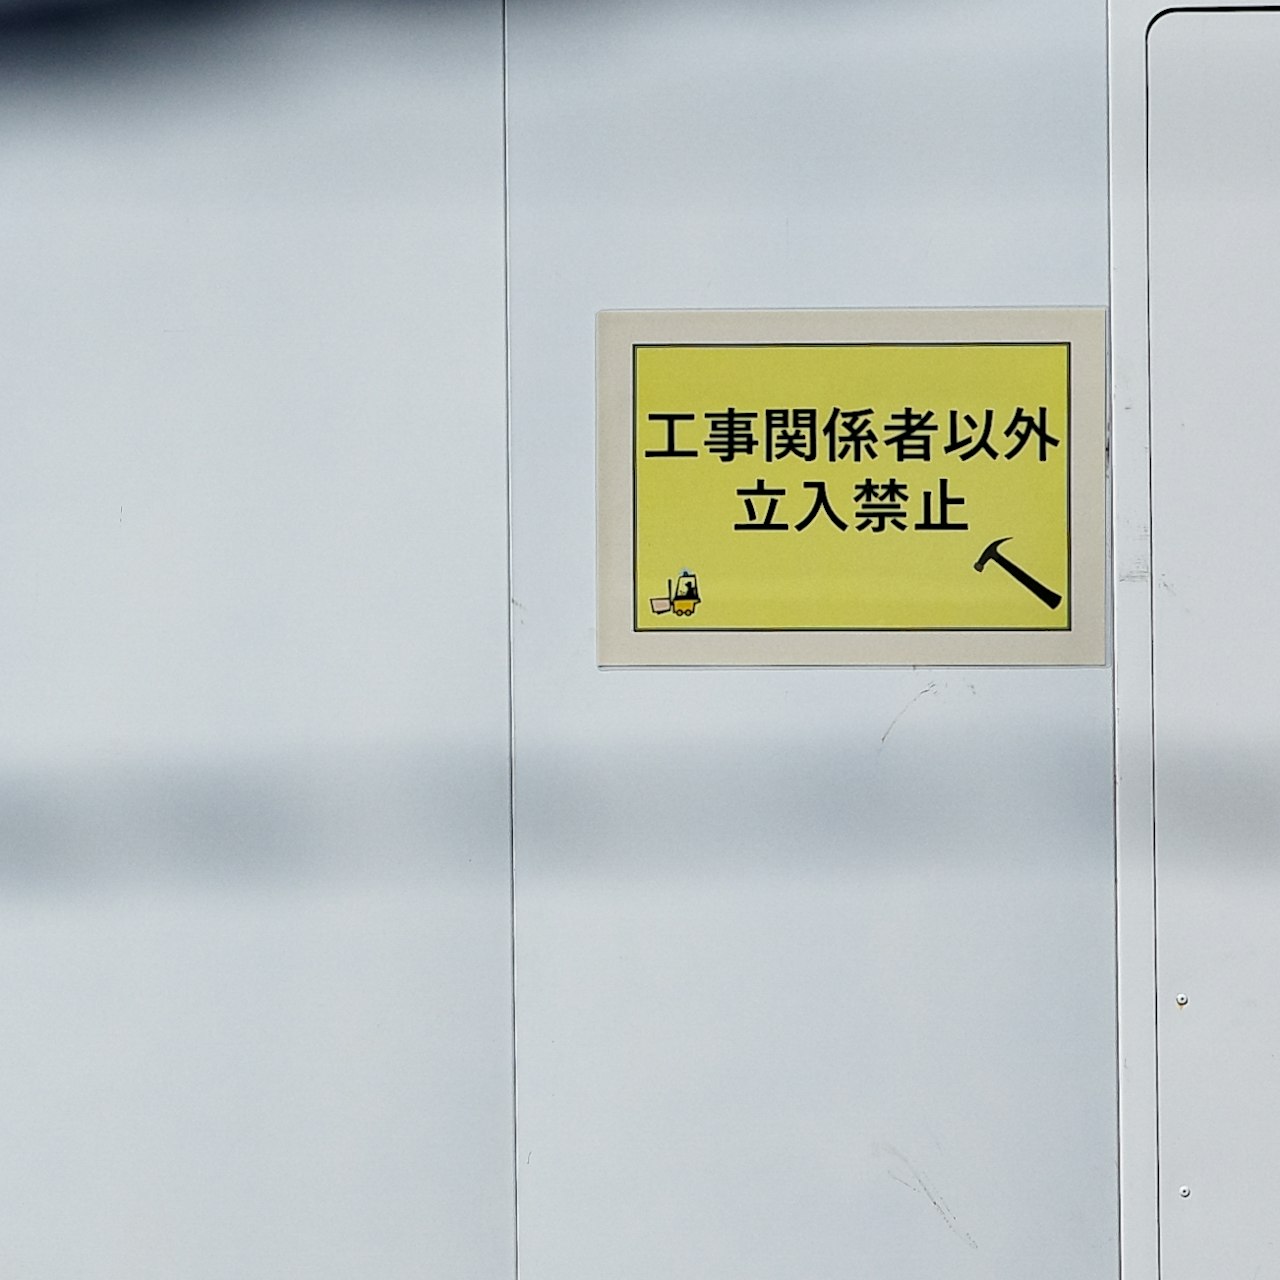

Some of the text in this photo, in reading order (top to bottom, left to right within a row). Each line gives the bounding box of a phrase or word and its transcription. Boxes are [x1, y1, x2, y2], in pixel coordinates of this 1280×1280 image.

[644, 406, 1060, 463] 工事関係者以外
[733, 477, 969, 533] 立入禁止
